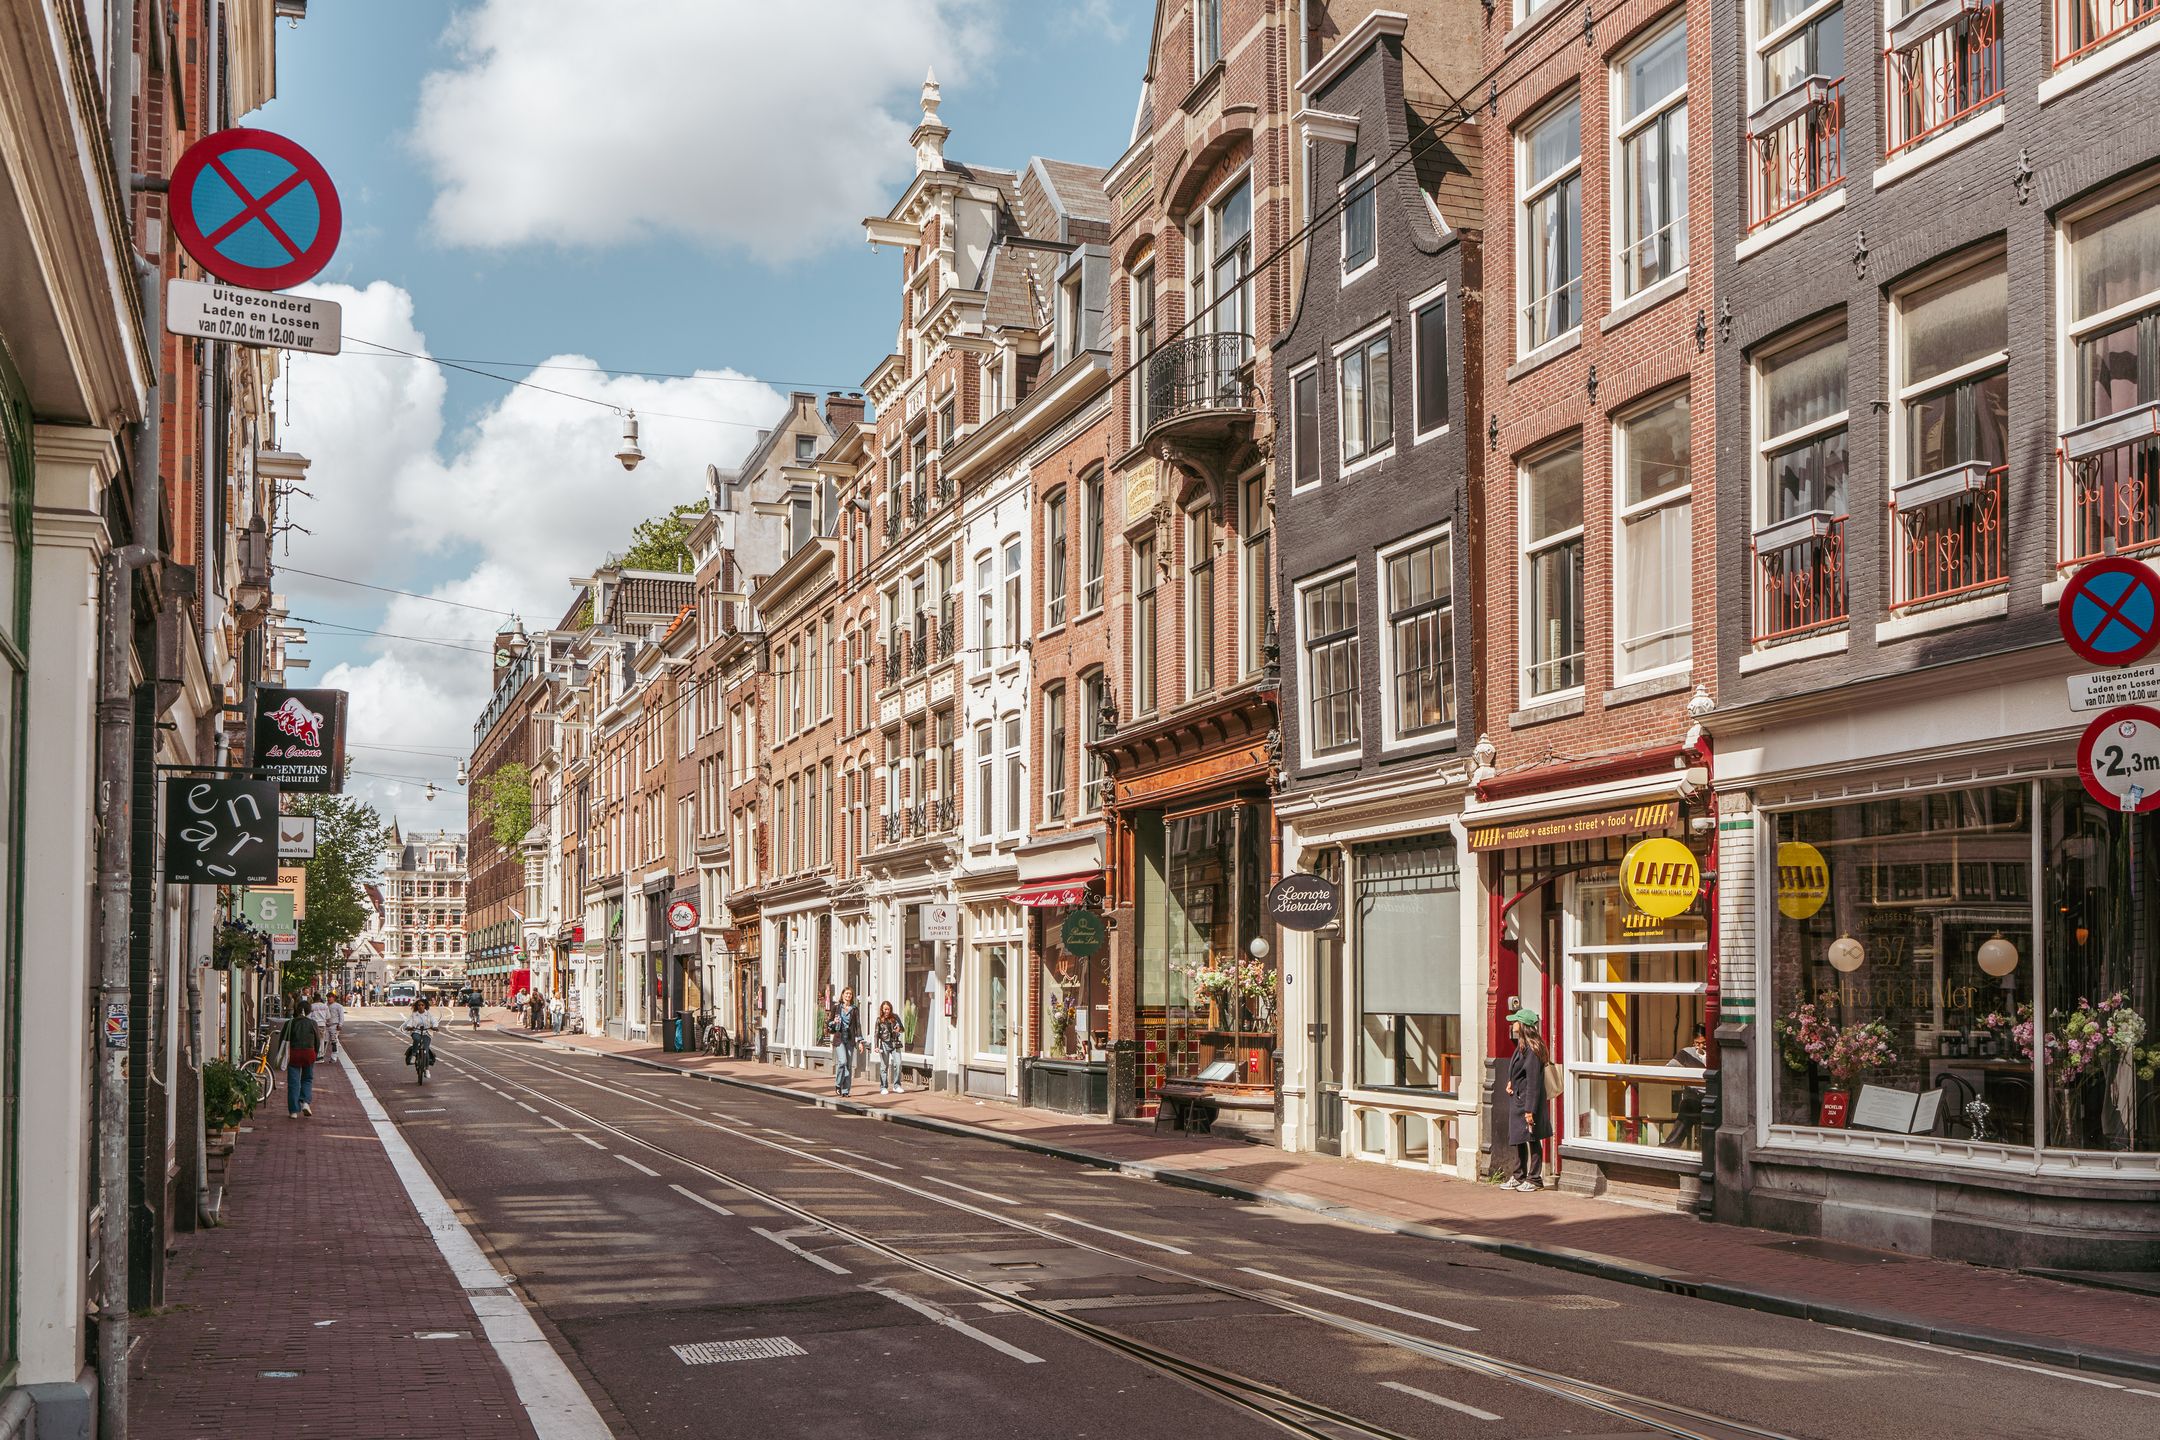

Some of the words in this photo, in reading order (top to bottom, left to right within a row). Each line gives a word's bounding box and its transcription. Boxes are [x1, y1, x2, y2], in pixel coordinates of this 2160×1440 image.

[213, 289, 311, 314] Uitgezonderd
[203, 303, 244, 319] Laden
[250, 312, 266, 323] en
[272, 313, 320, 330] Lossen
[199, 319, 217, 333] van
[220, 319, 247, 338] 07.00
[249, 324, 265, 341] t/m
[268, 327, 295, 344] 12.00
[297, 335, 314, 348] uur
[2092, 668, 2155, 684] Uitgezonderd
[2085, 697, 2097, 707] van
[2097, 693, 2115, 705] 07.00
[2128, 689, 2146, 701] 12.00
[2147, 689, 2158, 699] uur
[2087, 684, 2114, 695] Laden
[2117, 683, 2127, 691] en
[266, 745, 283, 757] La
[284, 744, 322, 759] Casona
[2104, 745, 2160, 777] 2,3m
[266, 774, 320, 783] restaurant
[1506, 829, 1530, 841] middle
[1537, 824, 1566, 836] eastern
[1574, 819, 1599, 832] street
[1607, 814, 1626, 827] food
[1635, 804, 1669, 828] LAFFA
[1634, 862, 1695, 886] LAFFA
[1277, 886, 1330, 900] Leonore
[1273, 900, 1332, 913] Sieraden
[1878, 936, 1905, 966] 57
[1876, 977, 1905, 1009] de
[1911, 978, 1929, 1008] la
[1935, 977, 1978, 1009] Mer
